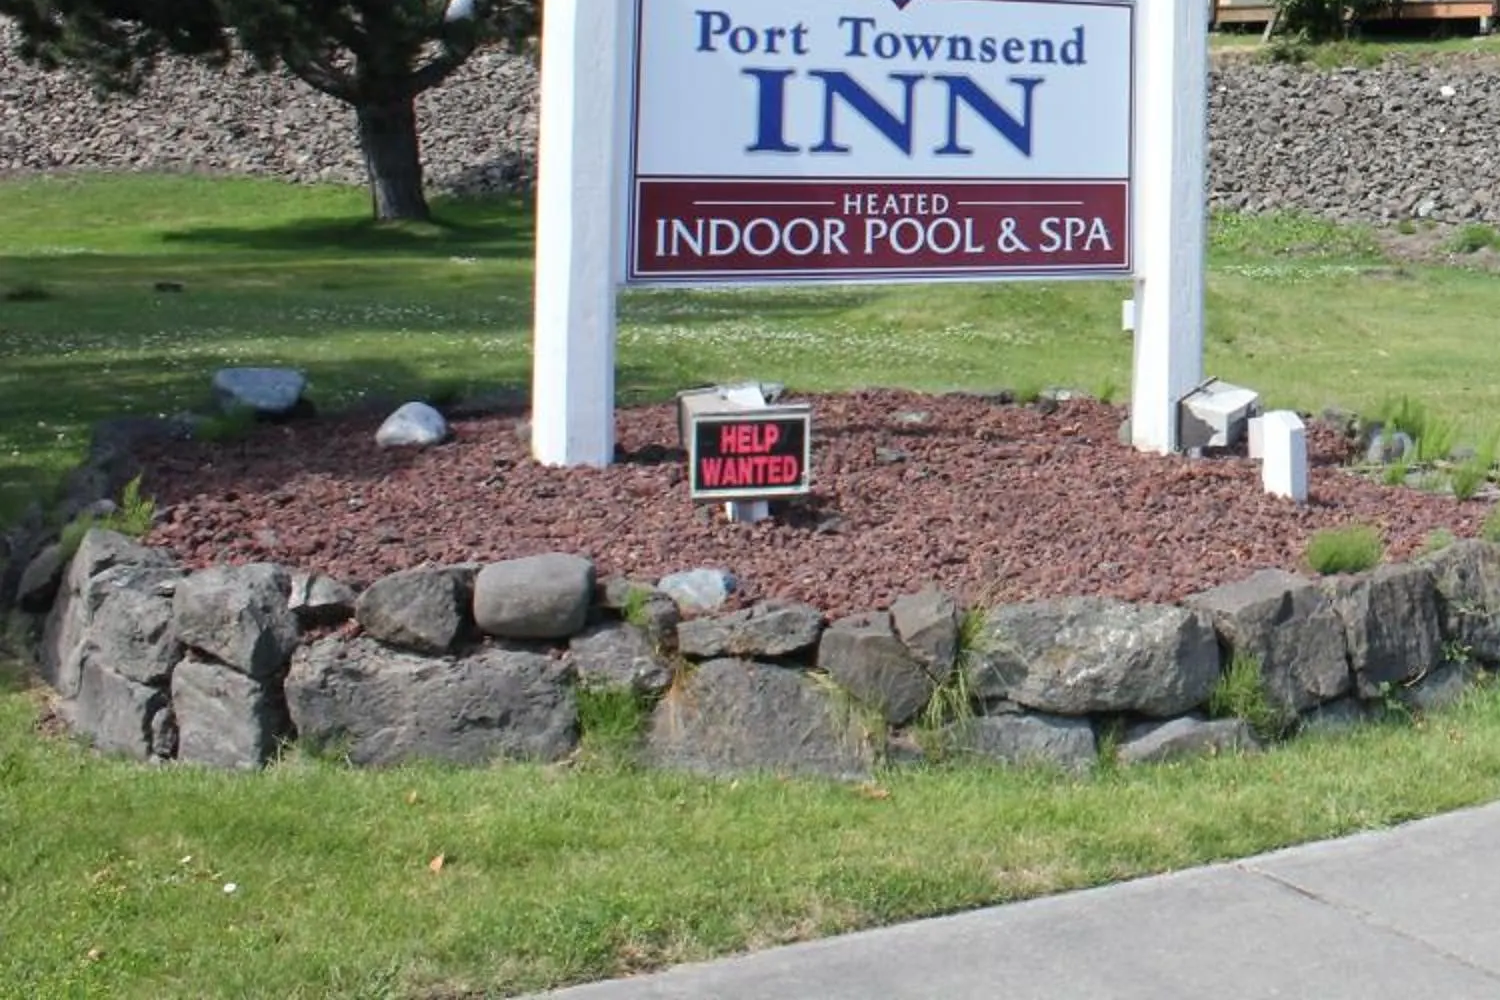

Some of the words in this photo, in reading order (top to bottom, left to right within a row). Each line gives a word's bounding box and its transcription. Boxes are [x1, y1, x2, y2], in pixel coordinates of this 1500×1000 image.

[695, 10, 809, 56] Port
[838, 16, 1087, 66] Townsend
[741, 67, 1045, 158] INN
[843, 193, 949, 215] HEATED
[655, 217, 849, 257] INDOOR
[864, 218, 985, 255] POOL
[997, 218, 1031, 253] &
[1039, 216, 1113, 253] SPA
[720, 423, 780, 454] HELP
[702, 455, 799, 486] WANTED
